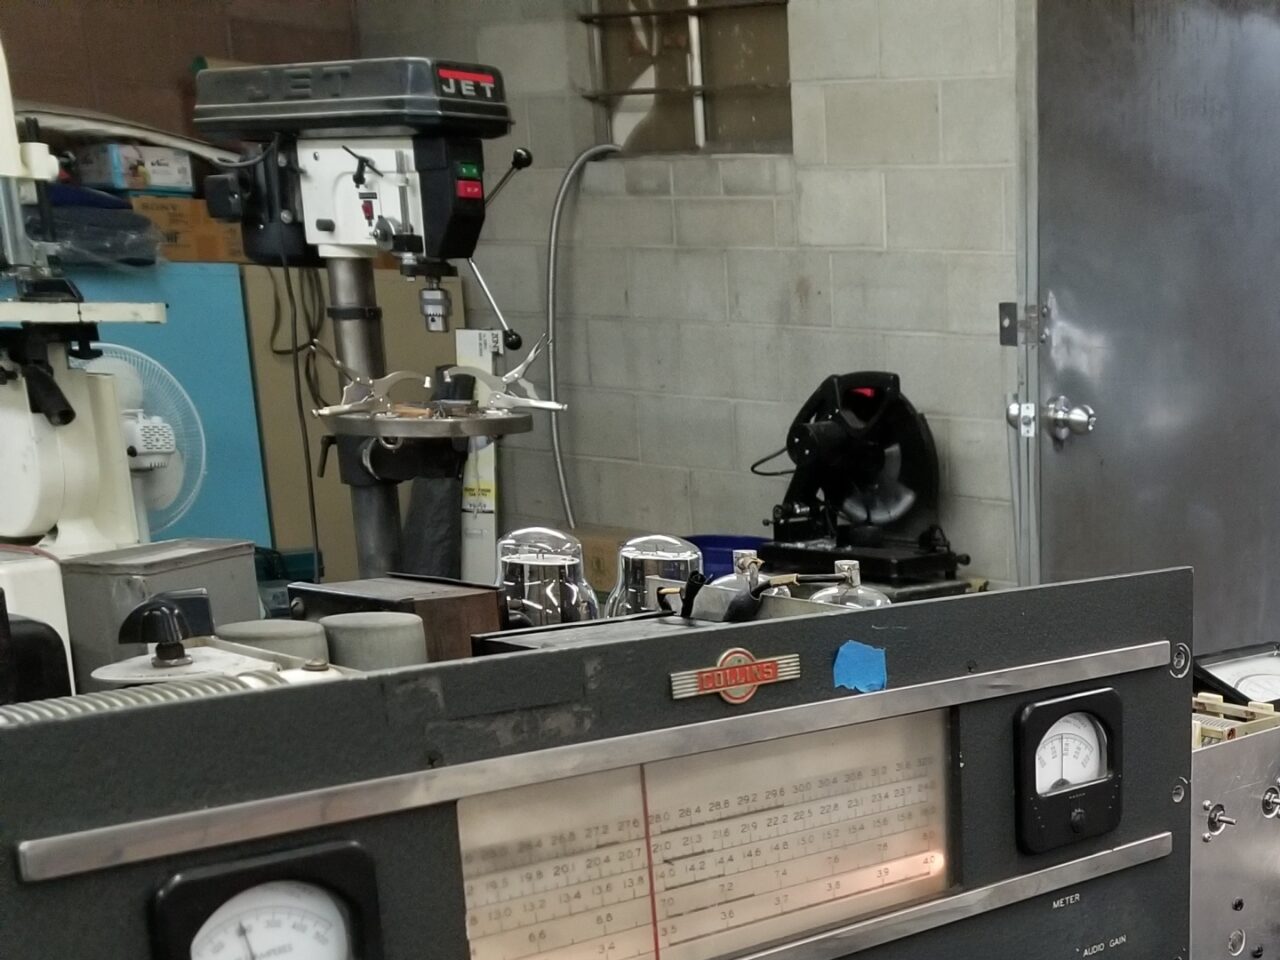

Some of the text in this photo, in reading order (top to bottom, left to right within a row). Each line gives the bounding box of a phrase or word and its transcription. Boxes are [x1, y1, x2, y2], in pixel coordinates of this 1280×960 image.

[248, 66, 350, 99] JET
[442, 78, 495, 98] JET
[702, 663, 774, 689] COLLINS
[1052, 893, 1080, 909] METER
[1082, 935, 1127, 958] AUDIO GAIN
